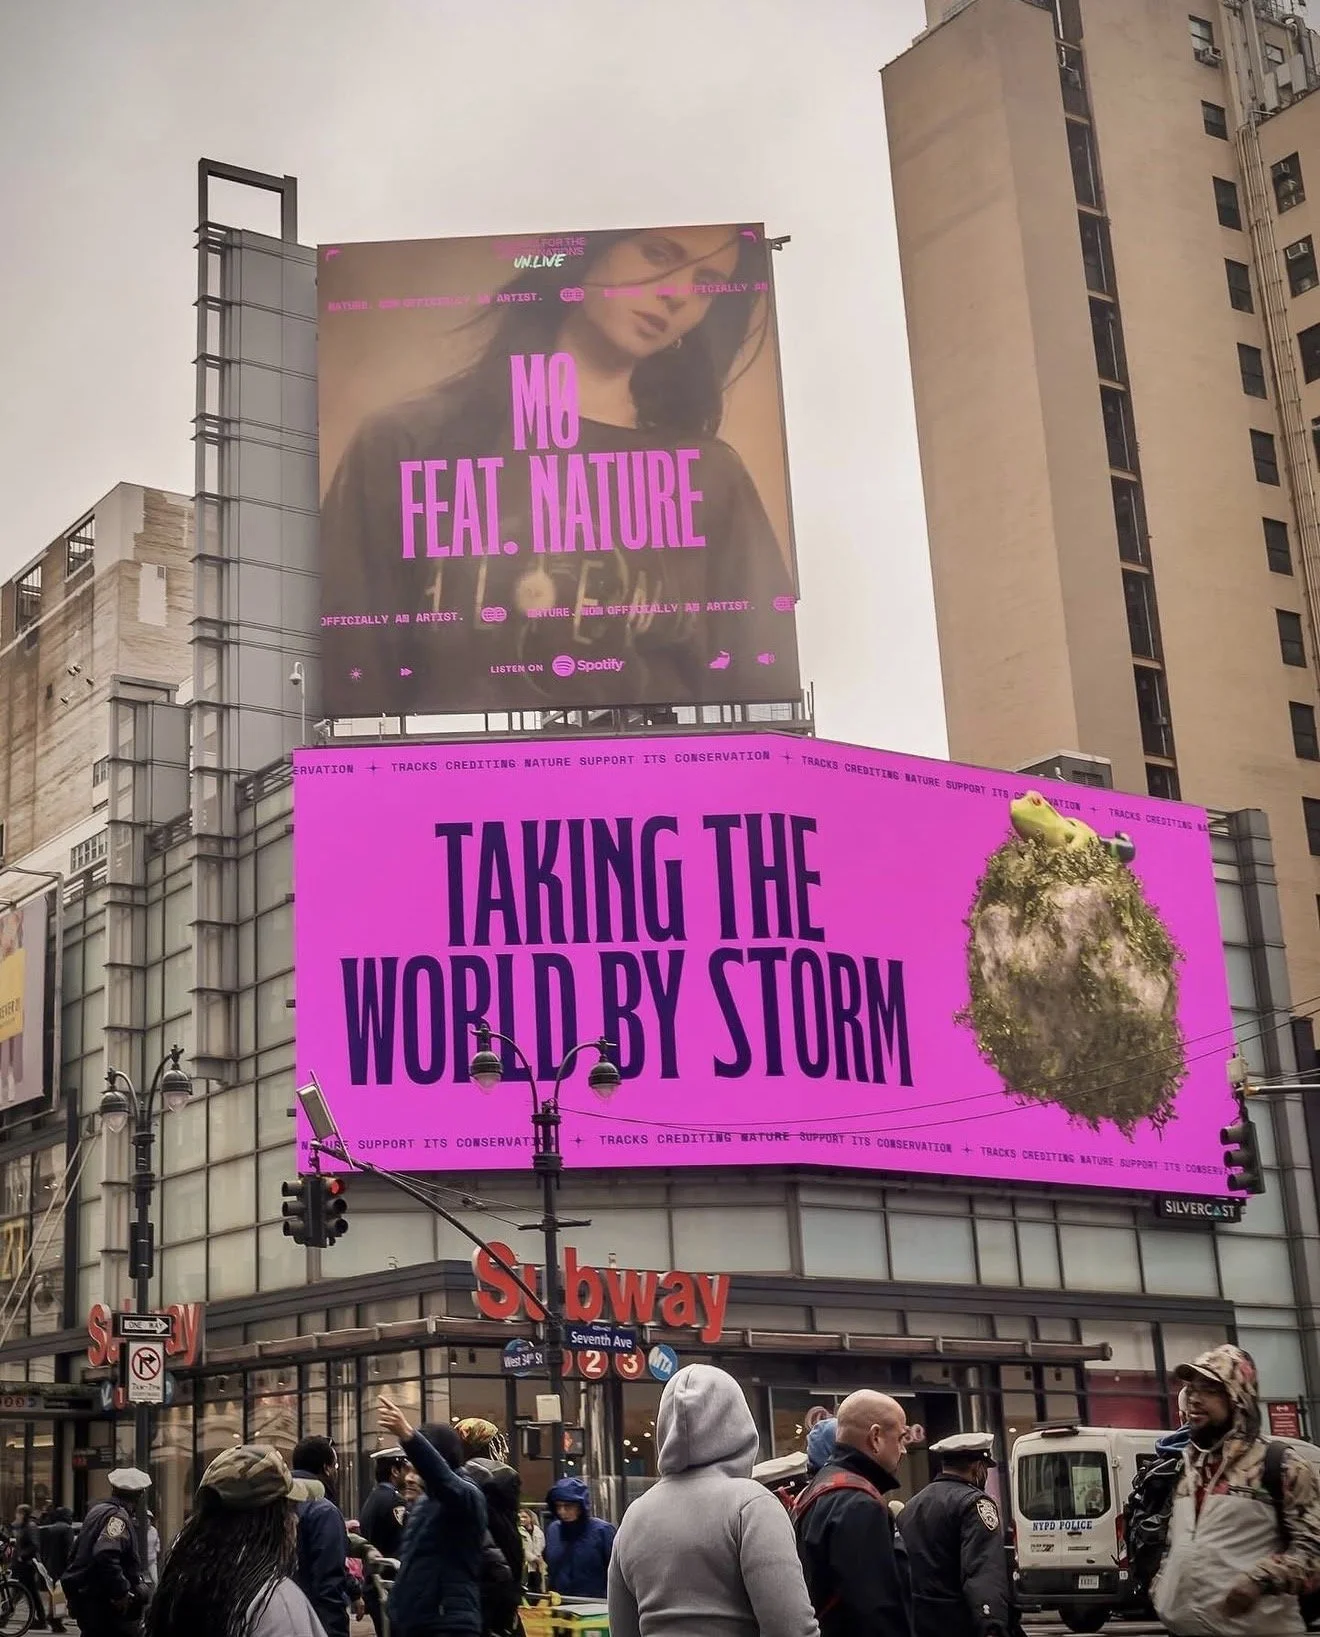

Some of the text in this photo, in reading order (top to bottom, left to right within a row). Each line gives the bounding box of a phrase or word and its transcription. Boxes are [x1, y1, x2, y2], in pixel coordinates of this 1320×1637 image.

[496, 292, 544, 303] ARTIST.
[399, 448, 707, 559] FEAT. NATURE
[415, 611, 464, 623] ARTIST.
[706, 600, 755, 612] ARTIST.
[490, 657, 625, 674] LISTEN ON Spotify
[391, 761, 438, 773] TRACKS
[445, 758, 516, 771] CREDITING
[524, 757, 571, 768] NATURE
[579, 754, 634, 767] SUPPORT
[643, 753, 667, 765] ITS
[675, 750, 770, 764] CONSERVATION
[801, 755, 839, 770] TRACKS
[844, 763, 900, 781] CREDITING
[905, 772, 940, 788] NATURE
[946, 780, 985, 796] SUPPORT
[991, 788, 1009, 799] ITS
[1109, 807, 1141, 822] TRACKS
[1146, 814, 1193, 830] CREDITING
[434, 812, 826, 947] TAKING THE
[340, 946, 915, 1088] WORLD BY STORM
[357, 1138, 415, 1150] SUPPORT
[424, 1138, 448, 1149] ITS
[599, 1134, 649, 1146] TRACKS
[657, 1132, 732, 1144] CREDITING
[740, 1131, 790, 1143] NATURE
[799, 1131, 844, 1145] SUPPORT
[851, 1135, 871, 1147] ITS
[877, 1137, 953, 1154] CONSERVATION
[980, 1145, 1017, 1159] TRACKS
[1022, 1150, 1075, 1164] CREDITING
[1080, 1155, 1114, 1167] NATURE
[1120, 1157, 1158, 1170] SUPPORT
[1164, 1161, 1181, 1173] ITS
[128, 1320, 142, 1329] ONE
[571, 1331, 633, 1349] Seventh Ave
[503, 1356, 521, 1369] West
[585, 1349, 639, 1374] 2 3
[1032, 1520, 1093, 1532] NYPD POLICE
